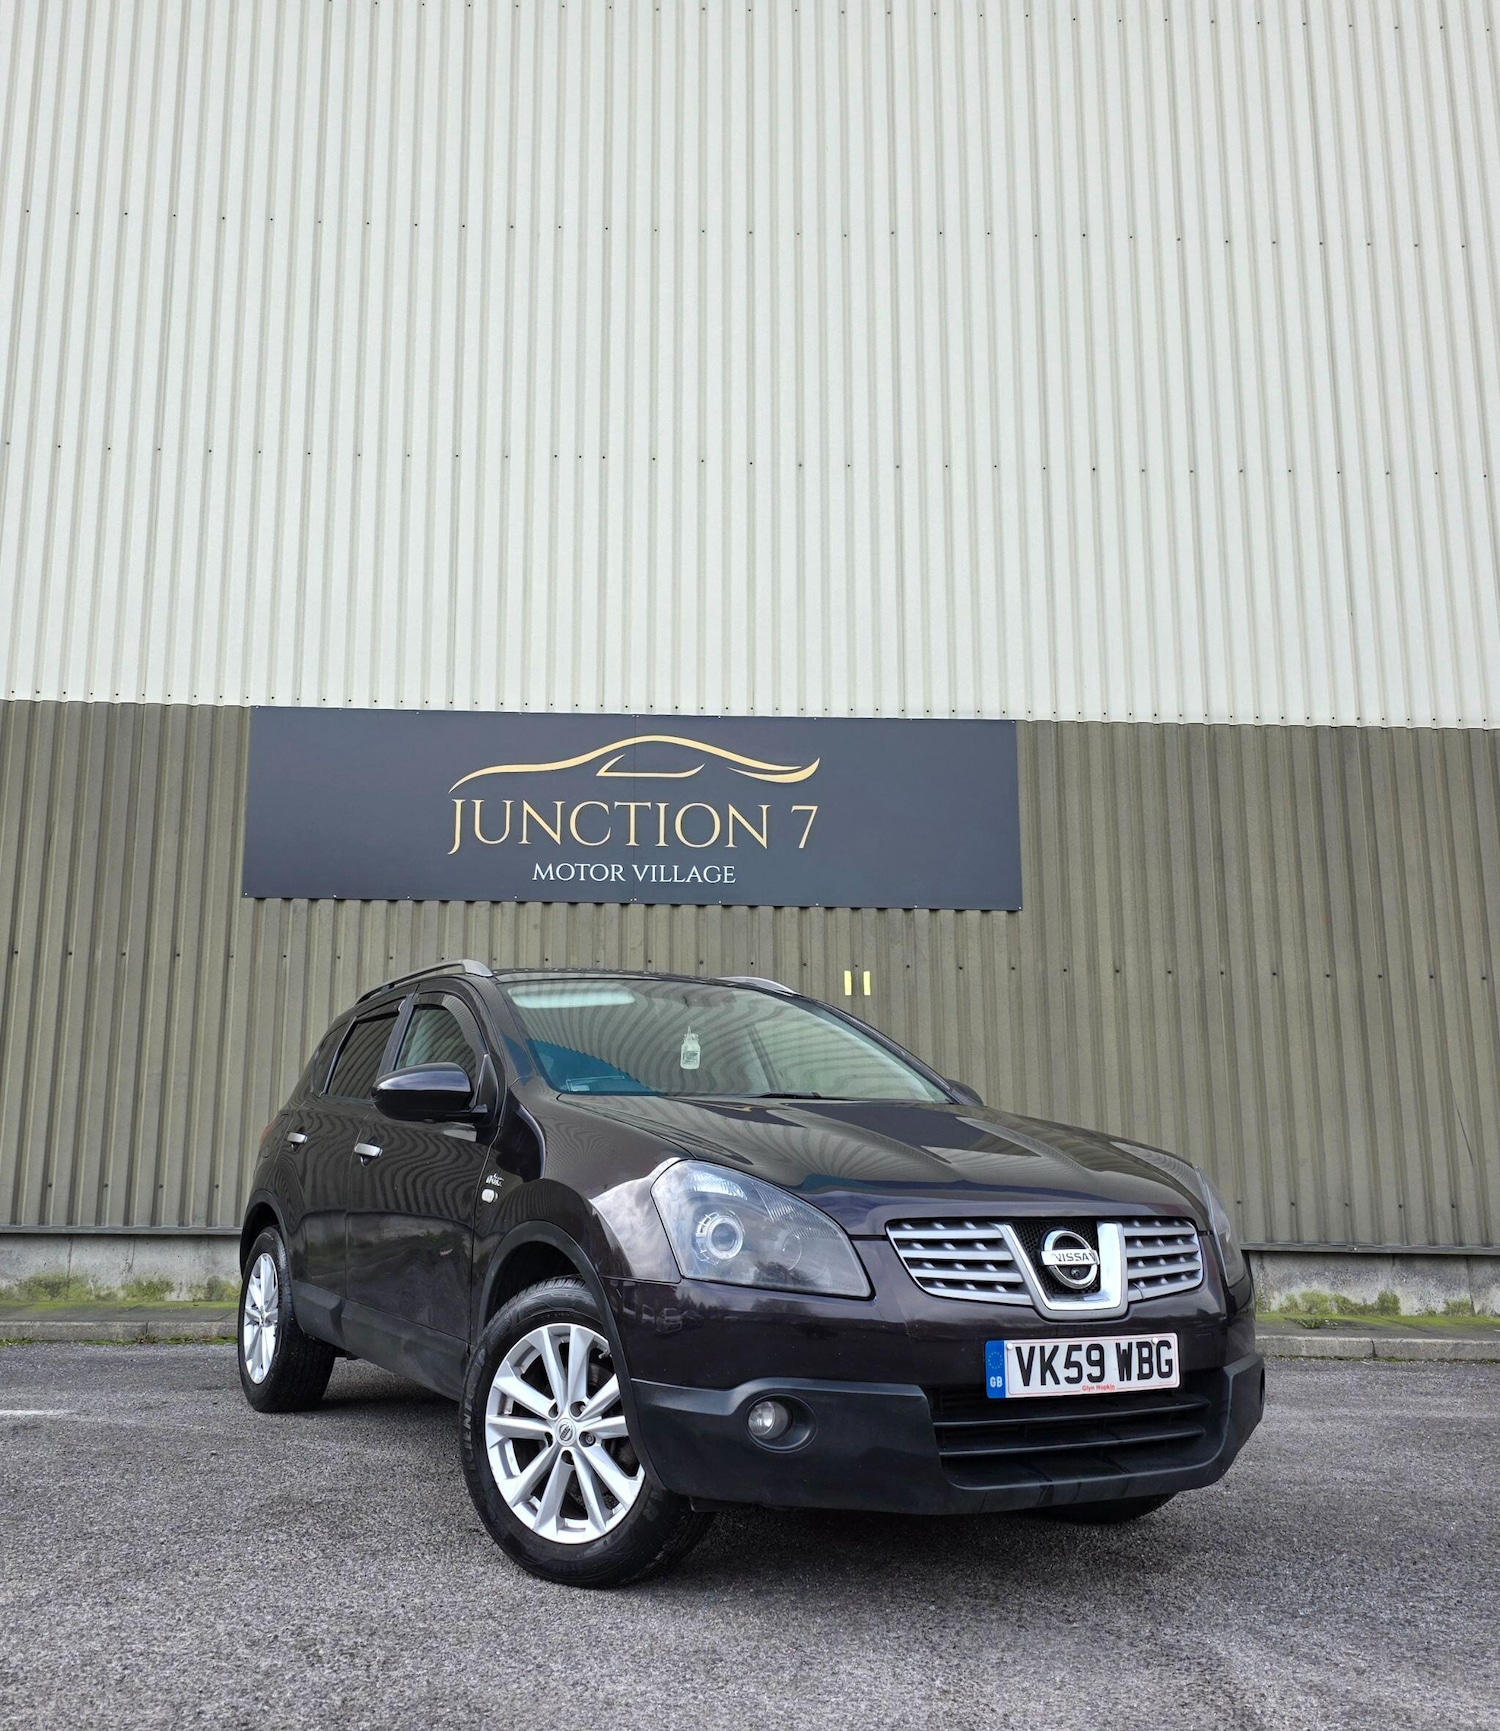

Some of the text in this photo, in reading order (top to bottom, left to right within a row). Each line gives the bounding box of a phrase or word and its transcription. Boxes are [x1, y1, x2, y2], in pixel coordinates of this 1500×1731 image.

[447, 798, 819, 855] JUNCTION 7
[531, 862, 737, 884] MOTOR VILLAGE
[1015, 1339, 1174, 1387] VK59 WBG
[989, 1375, 1003, 1388] GB
